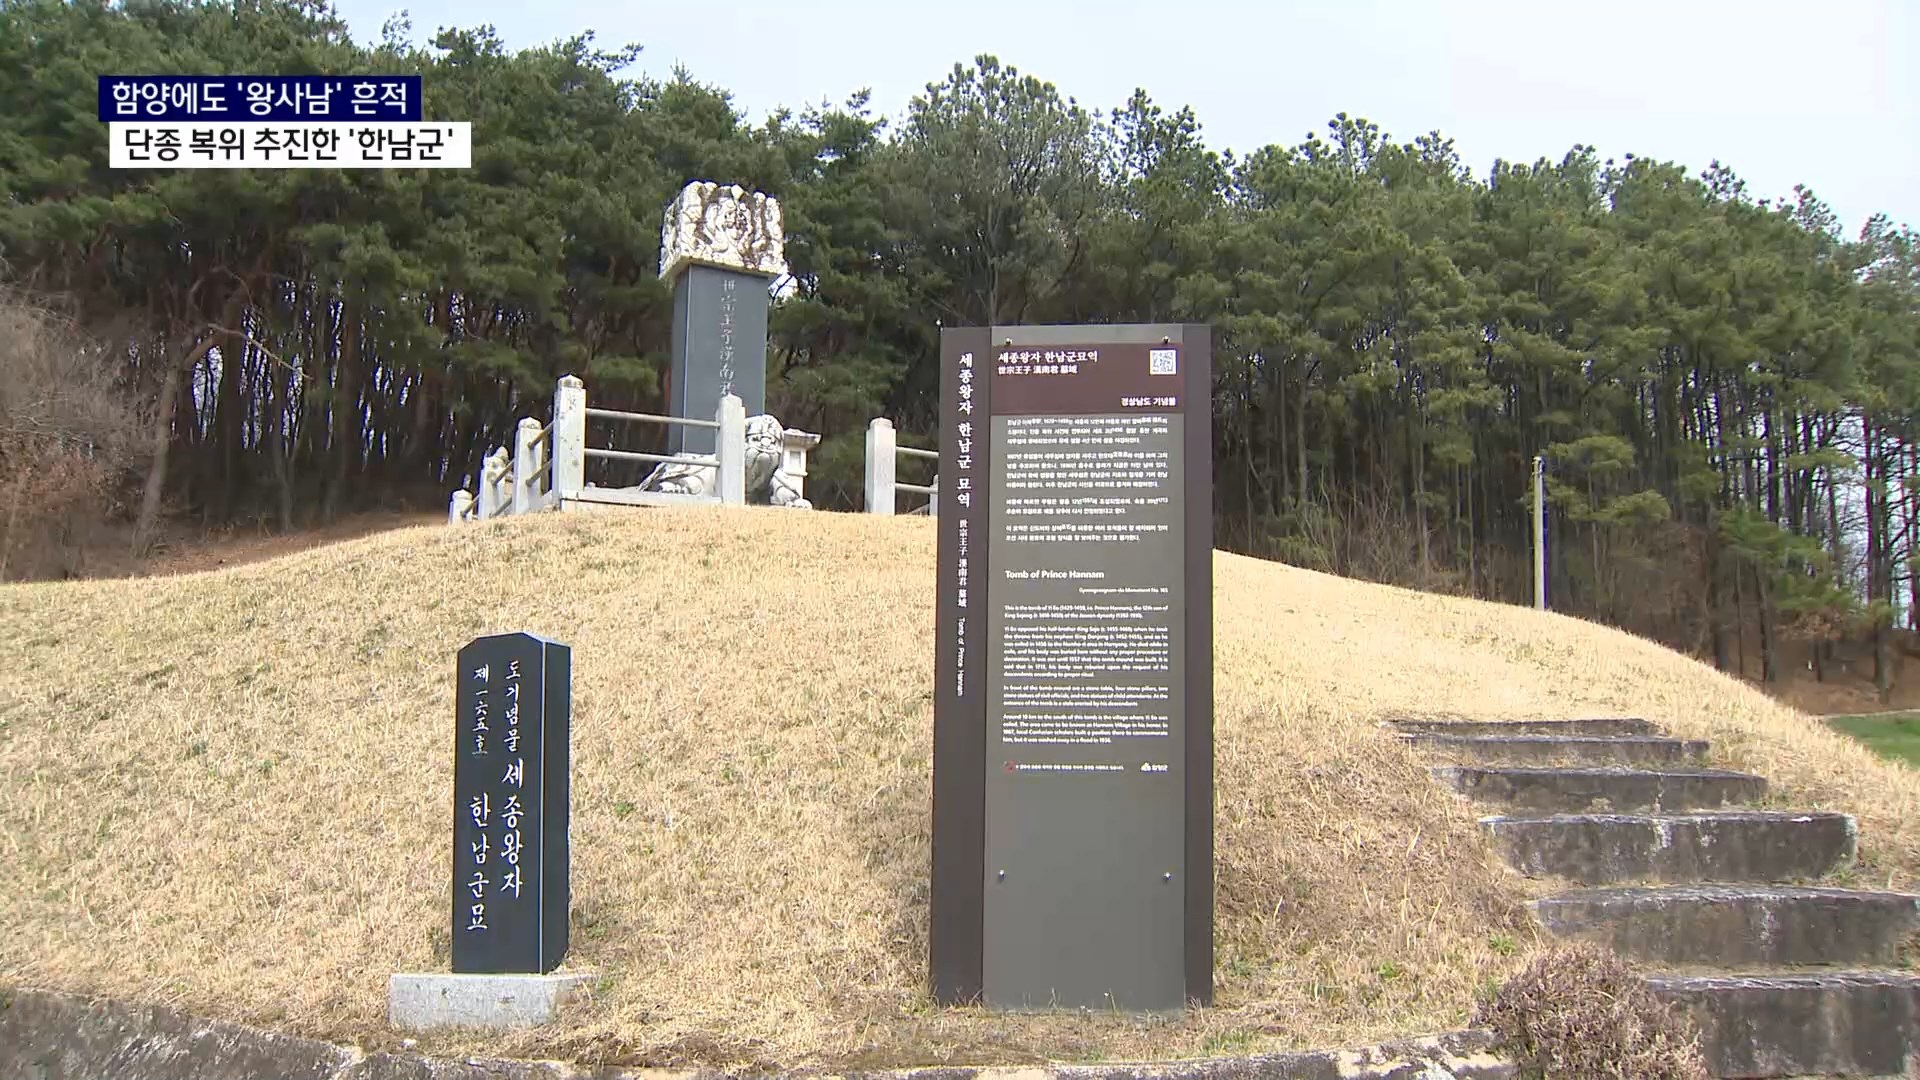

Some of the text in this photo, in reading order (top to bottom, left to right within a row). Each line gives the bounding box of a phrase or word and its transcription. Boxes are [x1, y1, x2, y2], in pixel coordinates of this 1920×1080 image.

[998, 350, 1098, 363] 세종왕자 한남군묘역
[998, 365, 1033, 375] 世宗王子
[1120, 397, 1176, 407] 경상남도 기념물
[957, 353, 974, 509] 세종왕자 한남군 묘역
[1005, 570, 1105, 579] Tomb of Prince Hannam
[957, 617, 966, 636] Tomb
[957, 637, 965, 645] of
[957, 646, 965, 668] Prince
[500, 660, 525, 900] 도기념물 세종왕자
[467, 792, 492, 931] 한남군묘
